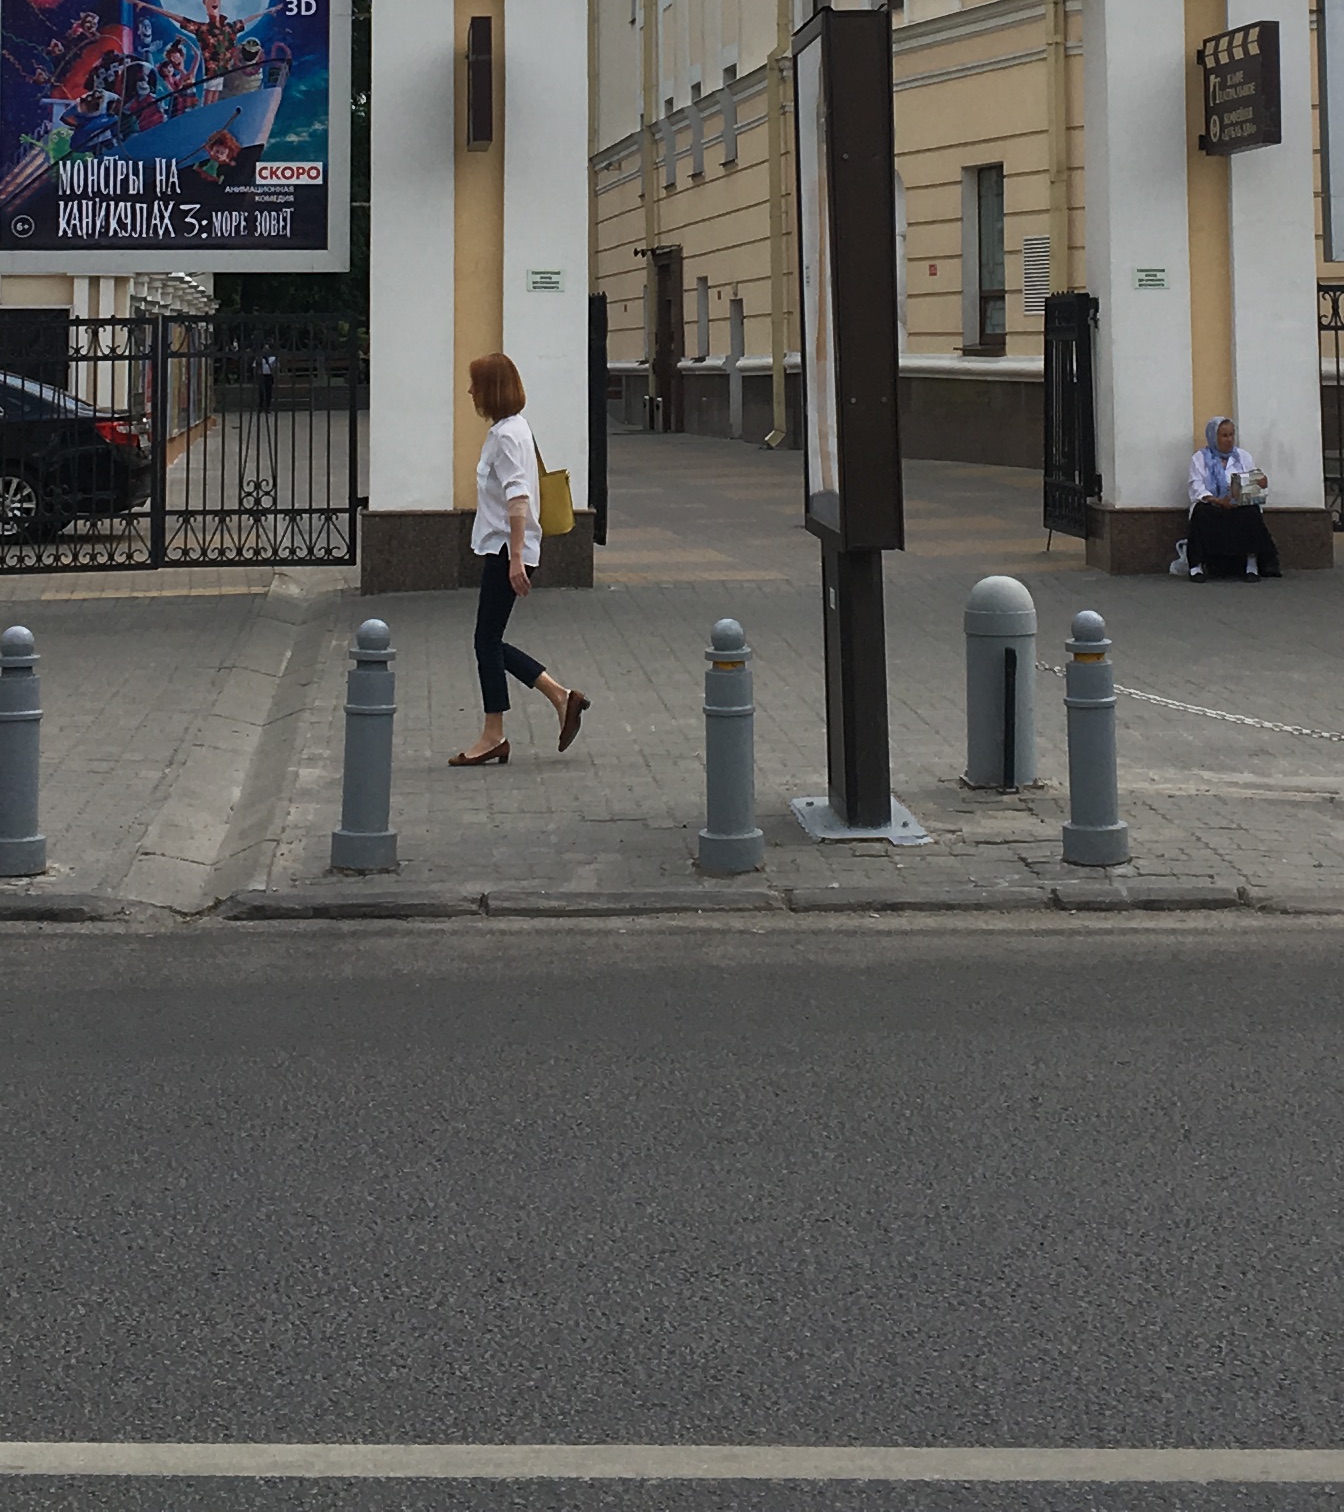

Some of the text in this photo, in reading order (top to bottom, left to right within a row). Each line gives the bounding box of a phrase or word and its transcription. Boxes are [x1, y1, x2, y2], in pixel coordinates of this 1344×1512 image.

[58, 155, 182, 197] МОНСТРЫ НА
[258, 165, 321, 180] СКОРО
[224, 185, 295, 194] АНИМАЦИОННАЯ
[254, 194, 295, 203] КОМЕДИЯ
[58, 198, 176, 239] КАНИКУЛАХ
[211, 210, 248, 237] МОРЕ
[16, 222, 30, 232] 6+
